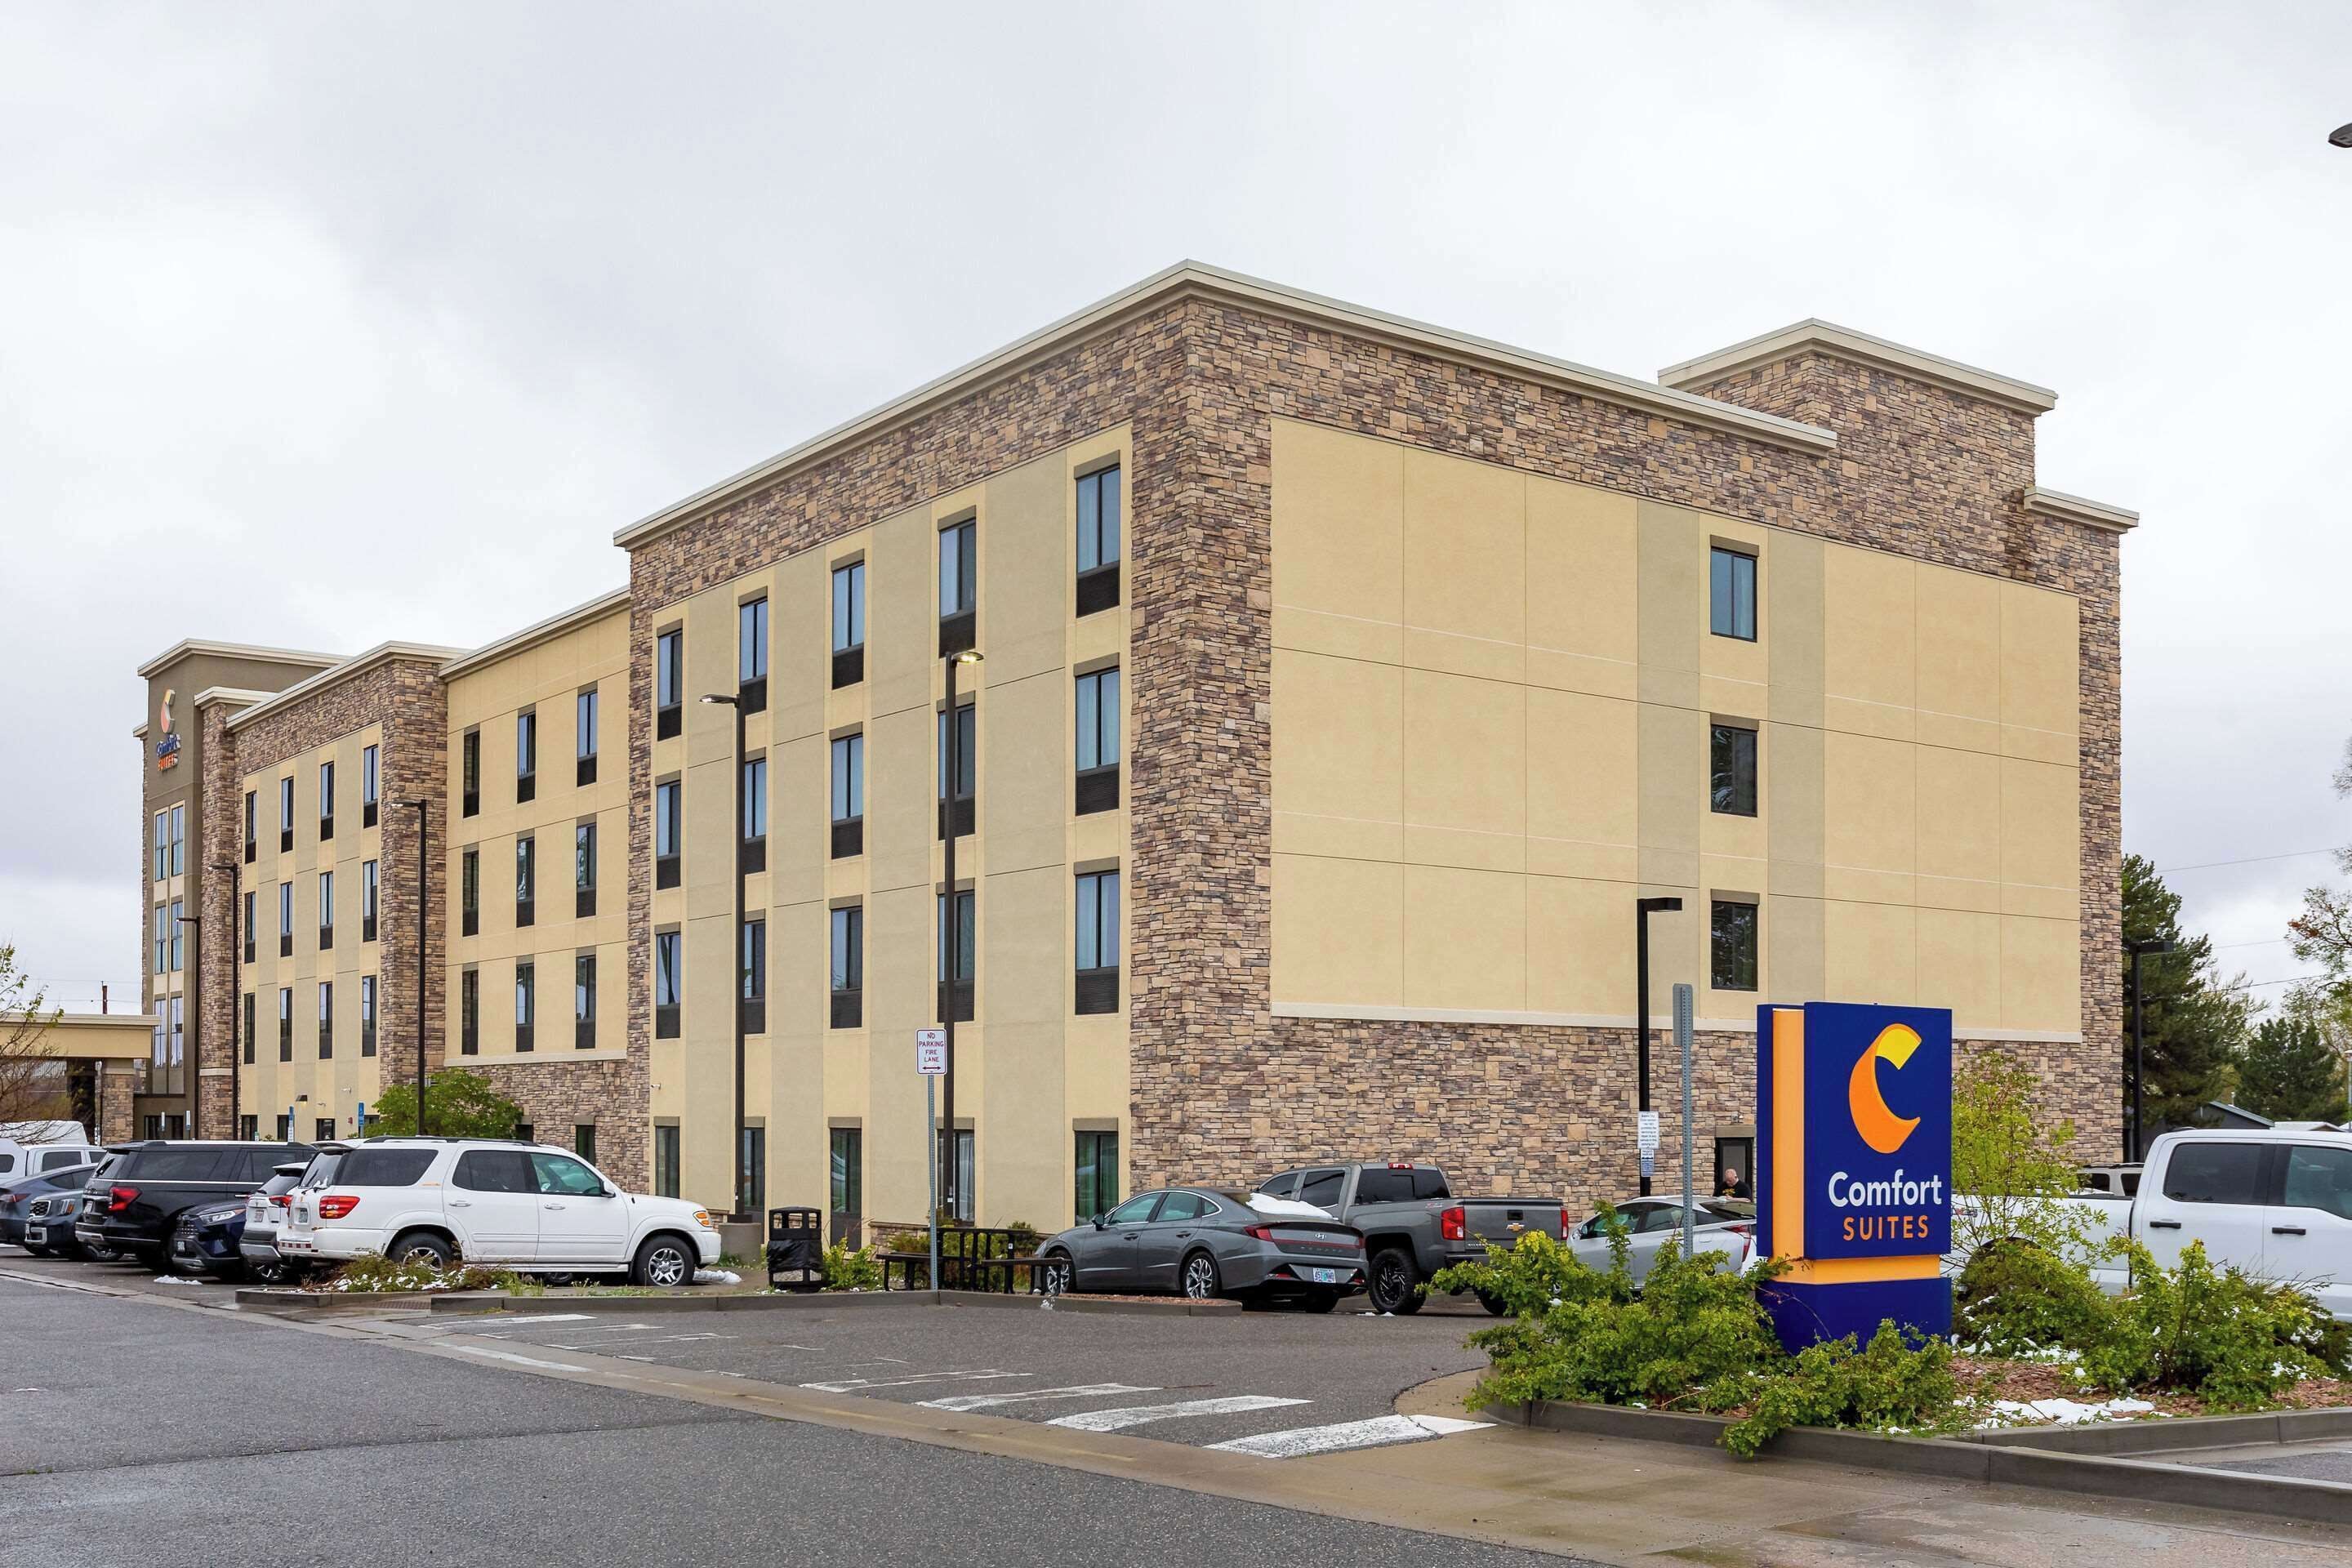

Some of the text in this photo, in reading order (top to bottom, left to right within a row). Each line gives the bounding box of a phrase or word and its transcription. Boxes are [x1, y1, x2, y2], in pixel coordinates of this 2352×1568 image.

[927, 1031, 936, 1040] NO
[1828, 1169, 1943, 1208] Comfort
[1842, 1214, 1929, 1241] SUITES
